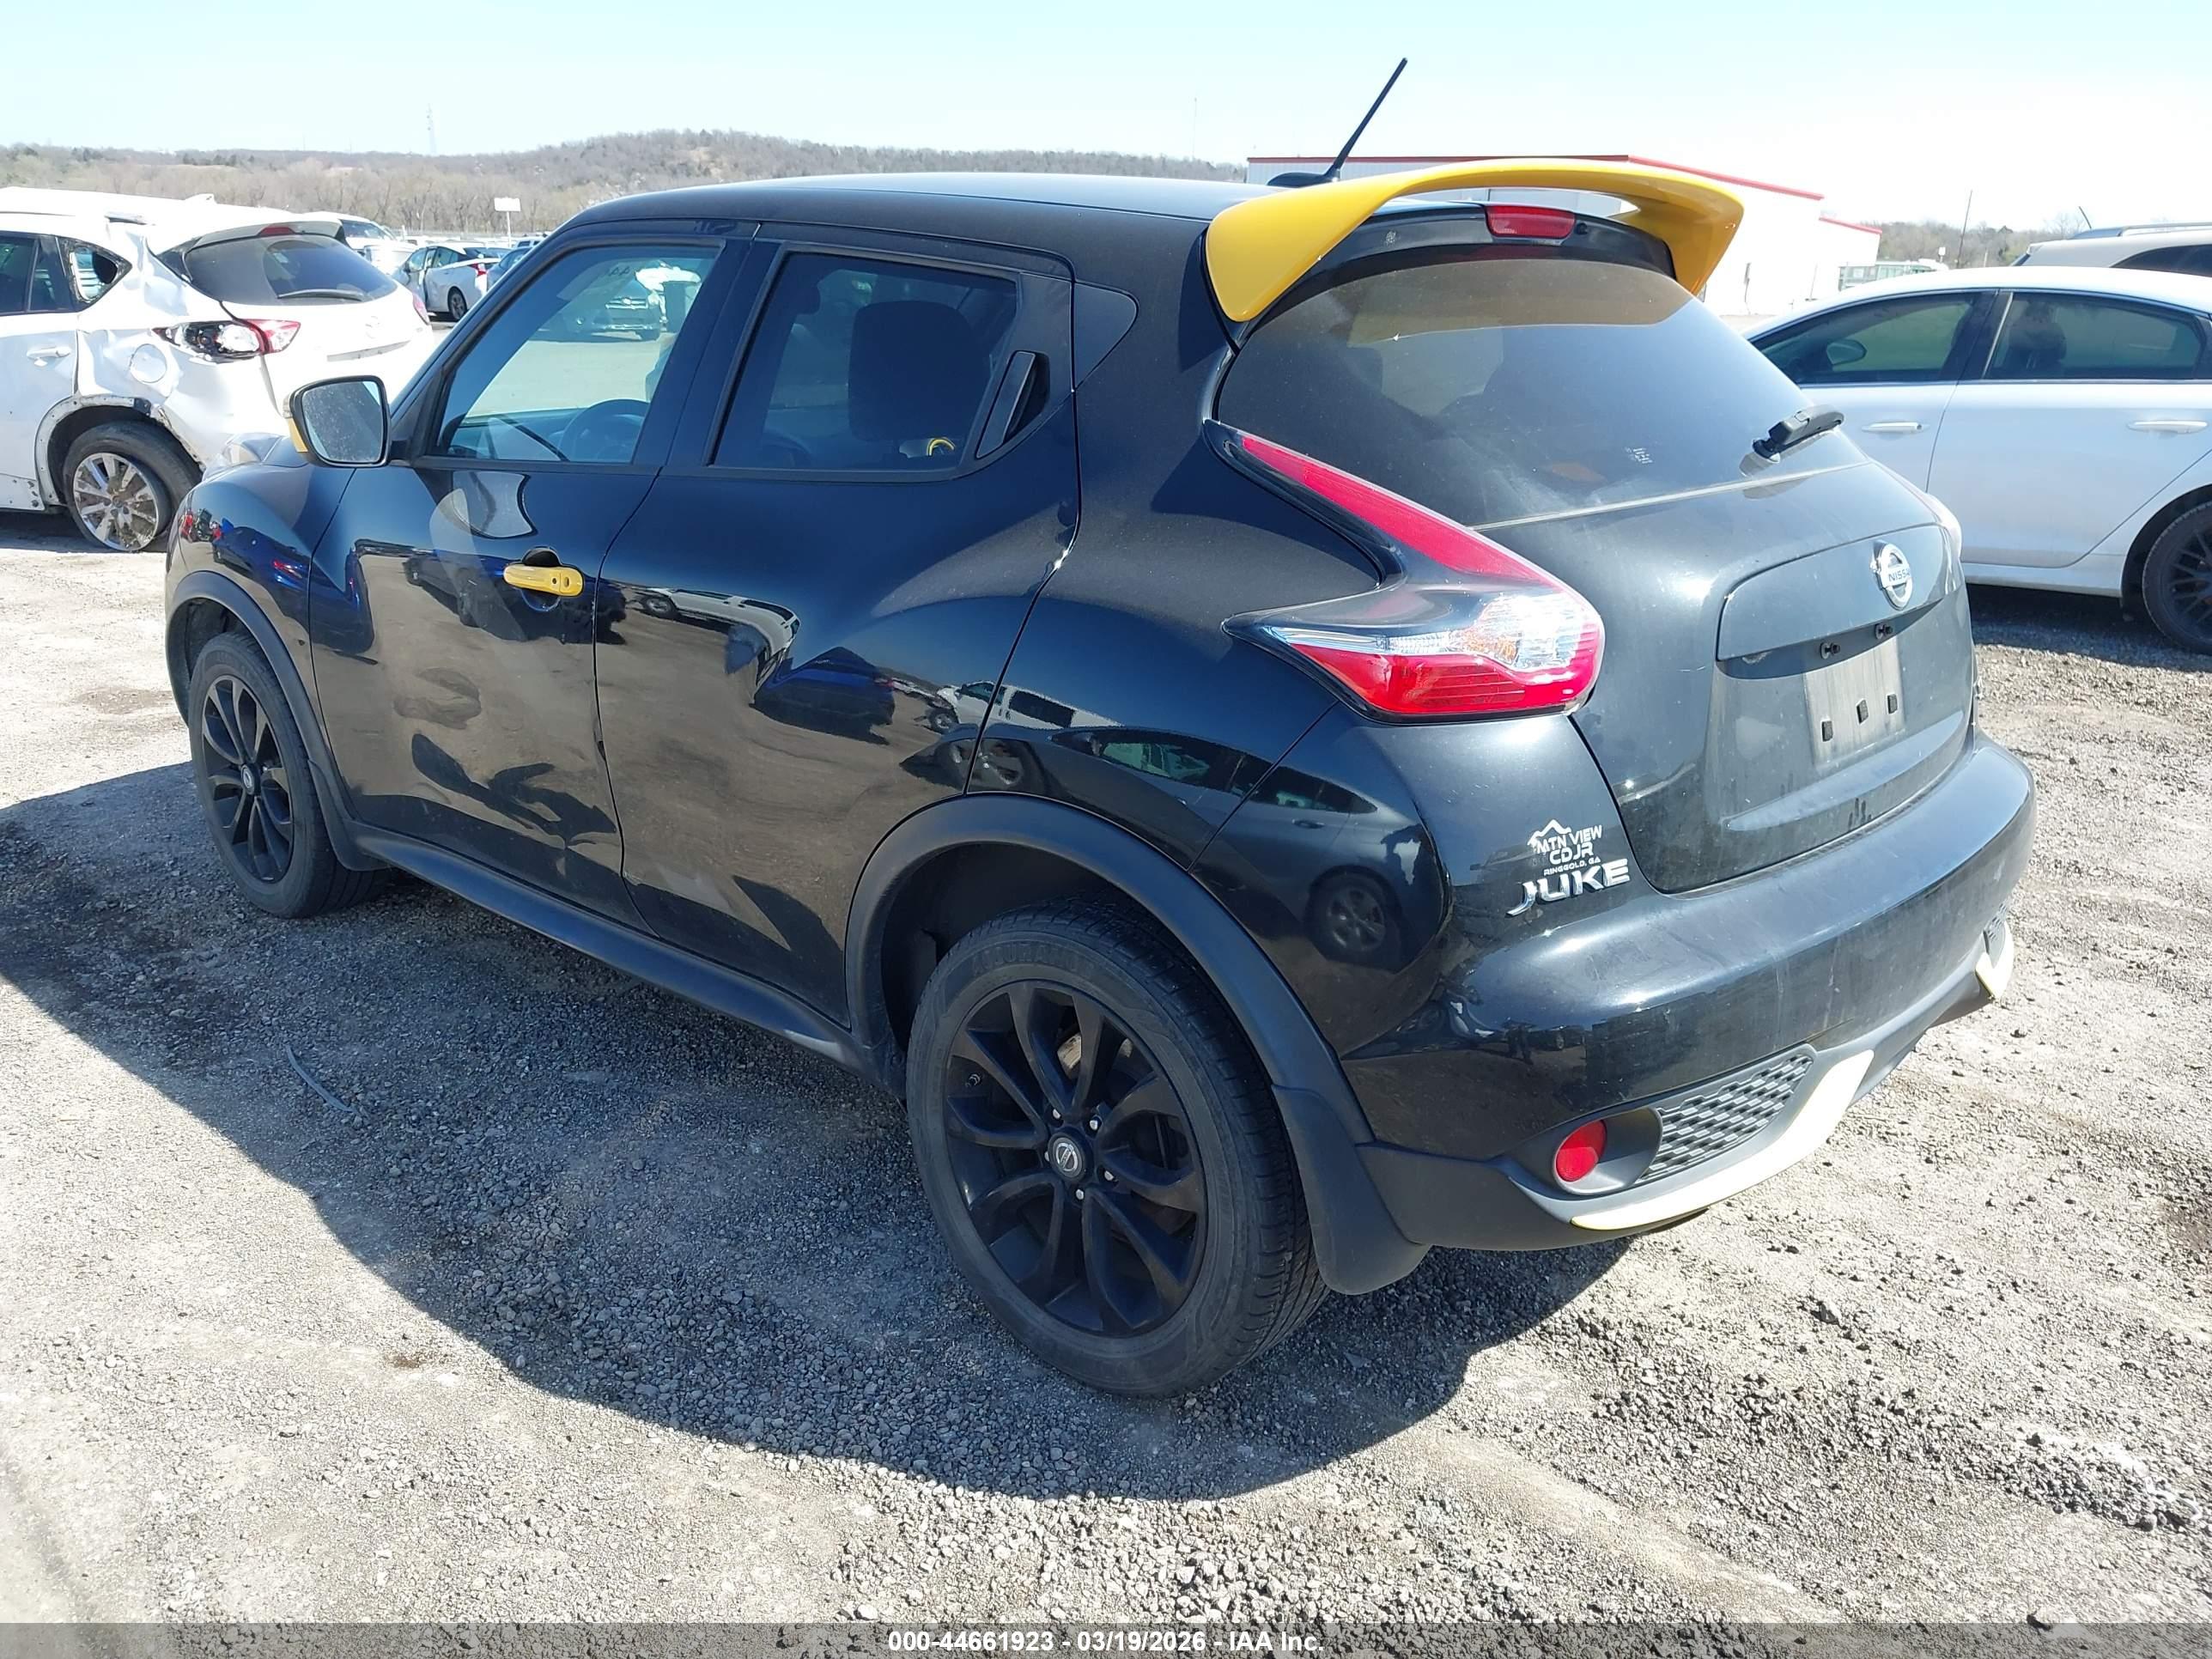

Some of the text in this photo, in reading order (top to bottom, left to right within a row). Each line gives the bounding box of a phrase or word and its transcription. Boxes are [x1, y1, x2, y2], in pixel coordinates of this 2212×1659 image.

[1888, 568, 1911, 581] NISSA
[1536, 824, 1602, 854] MTN VIEW
[1549, 842, 1594, 865] CDJR
[1544, 855, 1601, 876] RINGGOLD, GA
[1507, 858, 1630, 916] JUKE
